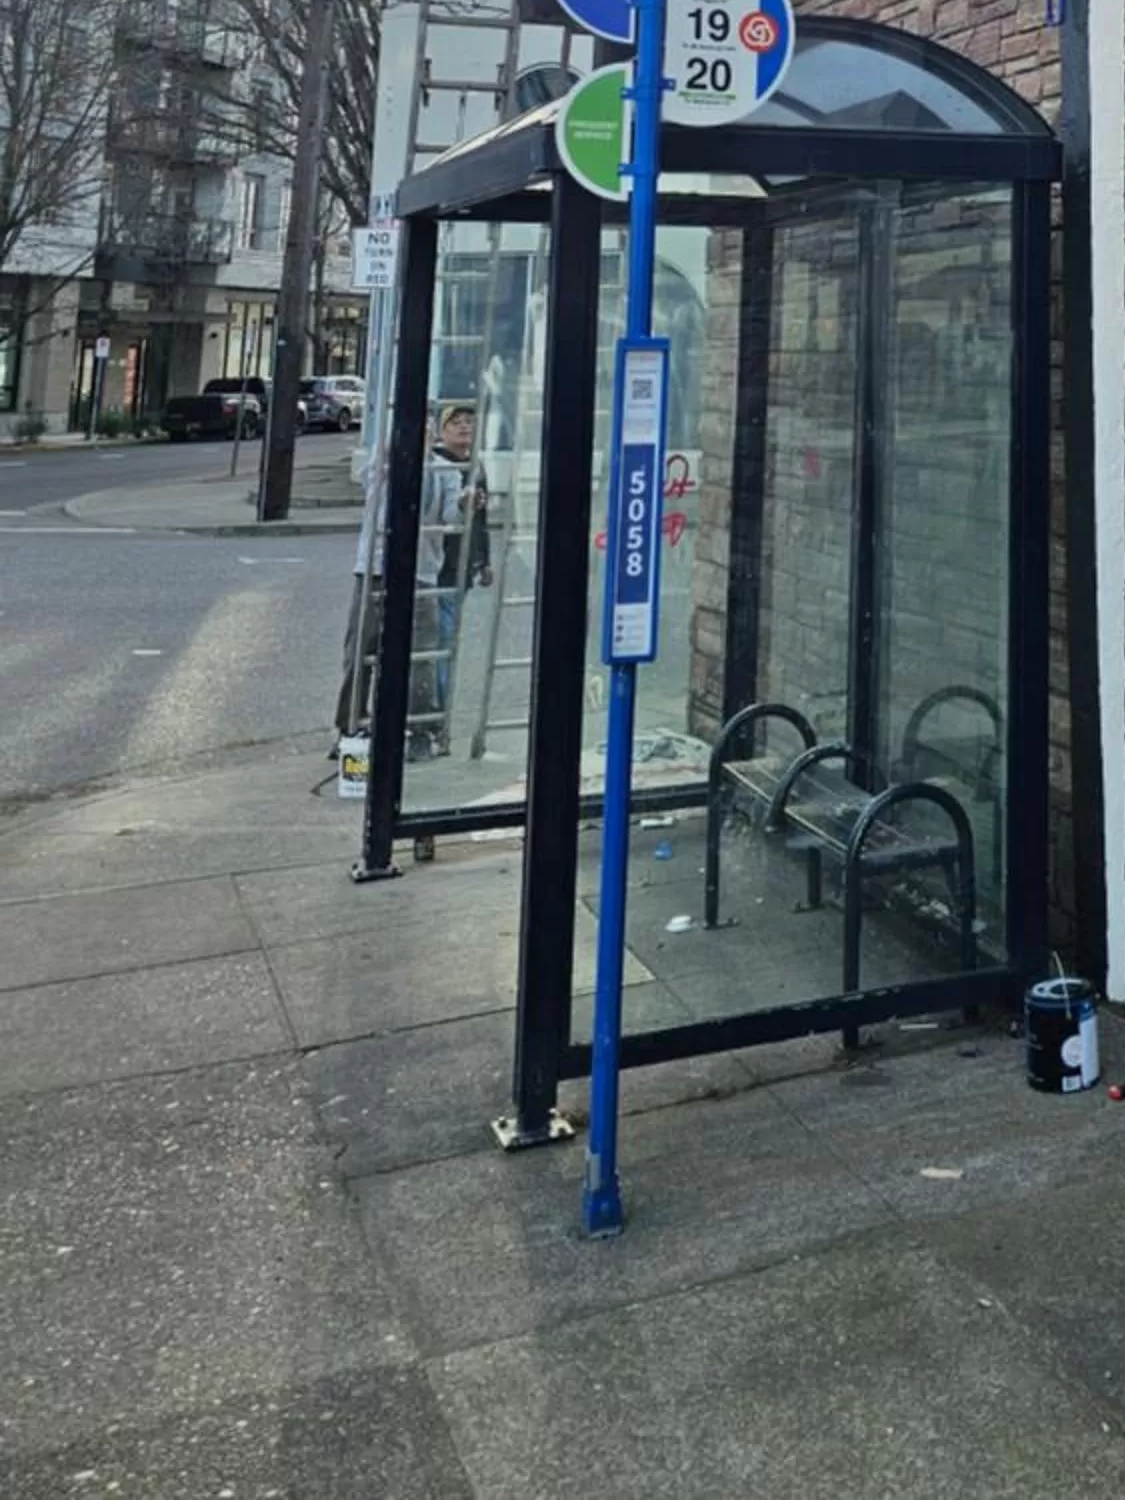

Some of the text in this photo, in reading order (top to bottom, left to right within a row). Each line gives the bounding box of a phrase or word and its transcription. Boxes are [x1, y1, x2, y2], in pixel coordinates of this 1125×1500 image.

[687, 7, 730, 42] 19
[686, 56, 732, 92] 20
[367, 231, 391, 245] NO
[626, 469, 646, 578] 5058
